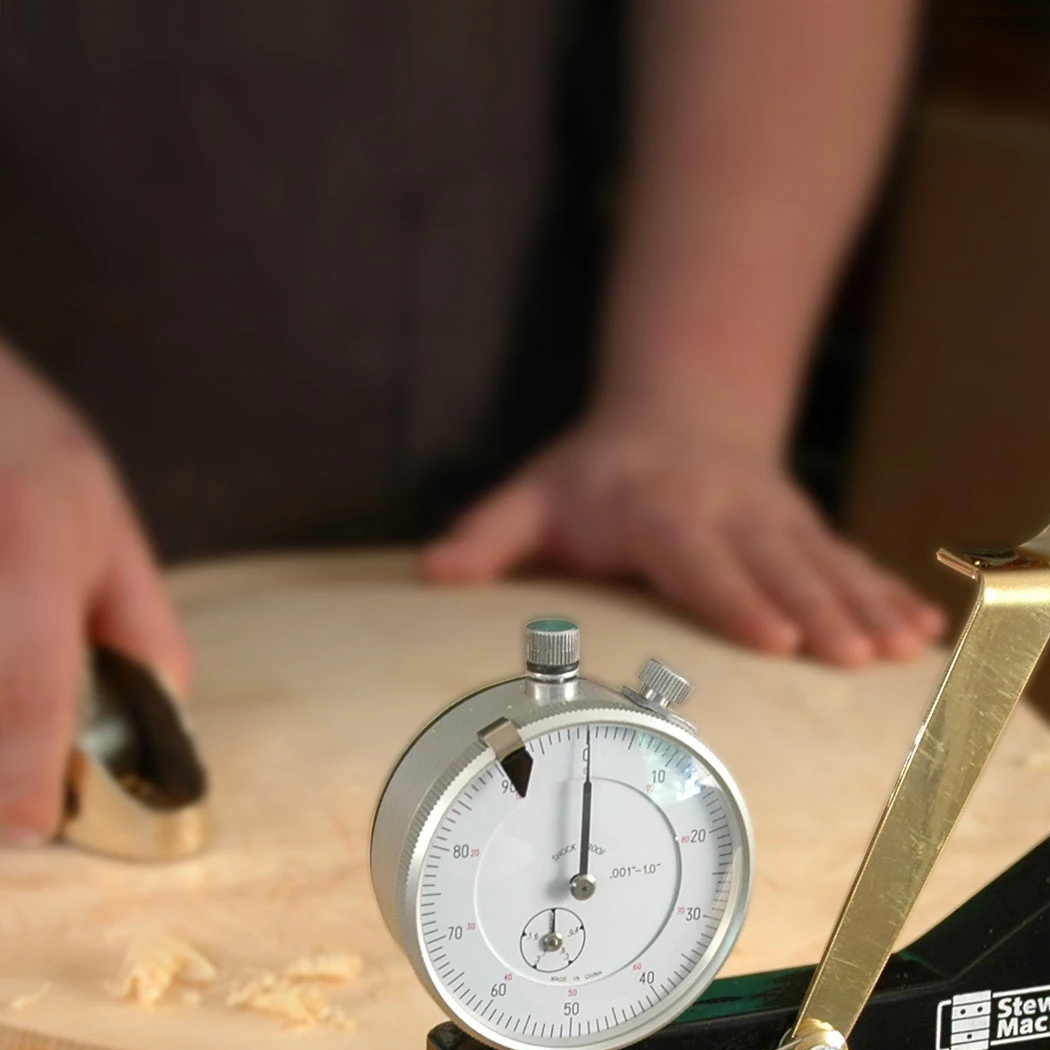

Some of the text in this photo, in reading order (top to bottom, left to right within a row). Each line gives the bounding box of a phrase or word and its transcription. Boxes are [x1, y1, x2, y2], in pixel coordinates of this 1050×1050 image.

[651, 769, 666, 784] 10
[690, 828, 706, 843] 20
[453, 844, 469, 859] 80
[470, 848, 480, 858] 20
[551, 843, 577, 862] SHOCK
[685, 906, 701, 921] 30
[447, 925, 463, 940] 70
[632, 963, 642, 971] 60
[503, 973, 513, 982] 40
[638, 971, 655, 984] 40
[490, 983, 507, 998] 60
[568, 988, 578, 997] 50
[563, 1002, 579, 1016] 50
